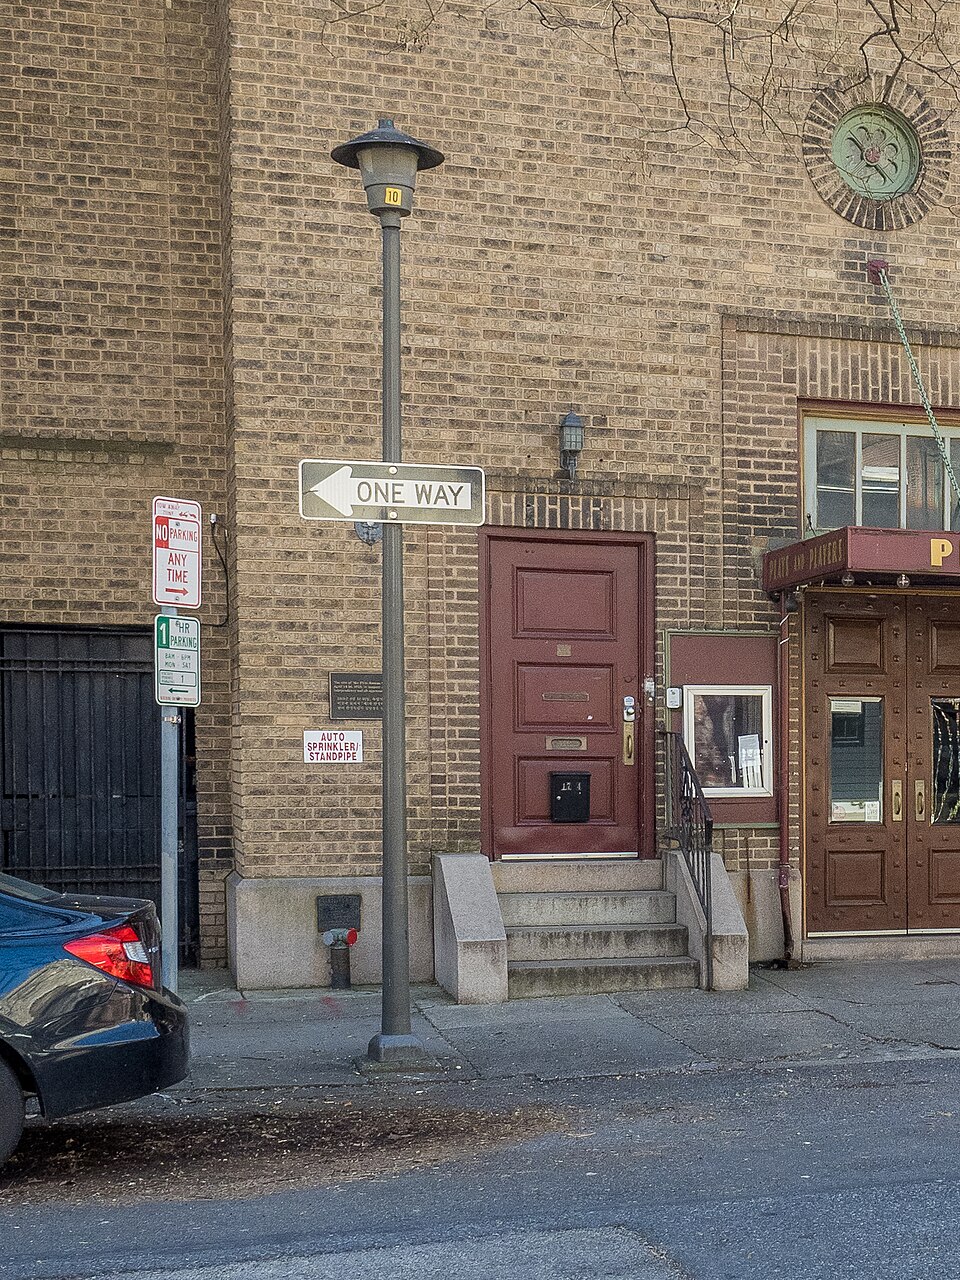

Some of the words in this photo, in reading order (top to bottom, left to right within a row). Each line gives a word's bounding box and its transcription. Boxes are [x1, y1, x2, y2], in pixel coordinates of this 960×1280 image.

[388, 191, 398, 202] 10
[357, 481, 405, 503] ONE
[415, 483, 464, 506] WAY
[156, 523, 168, 541] NO
[170, 528, 198, 542] PARKING
[168, 552, 187, 566] ANY
[167, 568, 188, 583] TIME
[160, 623, 166, 645] 1
[178, 622, 190, 634] HR
[170, 635, 197, 648] PARKING
[320, 732, 345, 741] AUTO
[307, 742, 359, 751] SPRINKLER/
[309, 752, 357, 761] STANDPIPE
